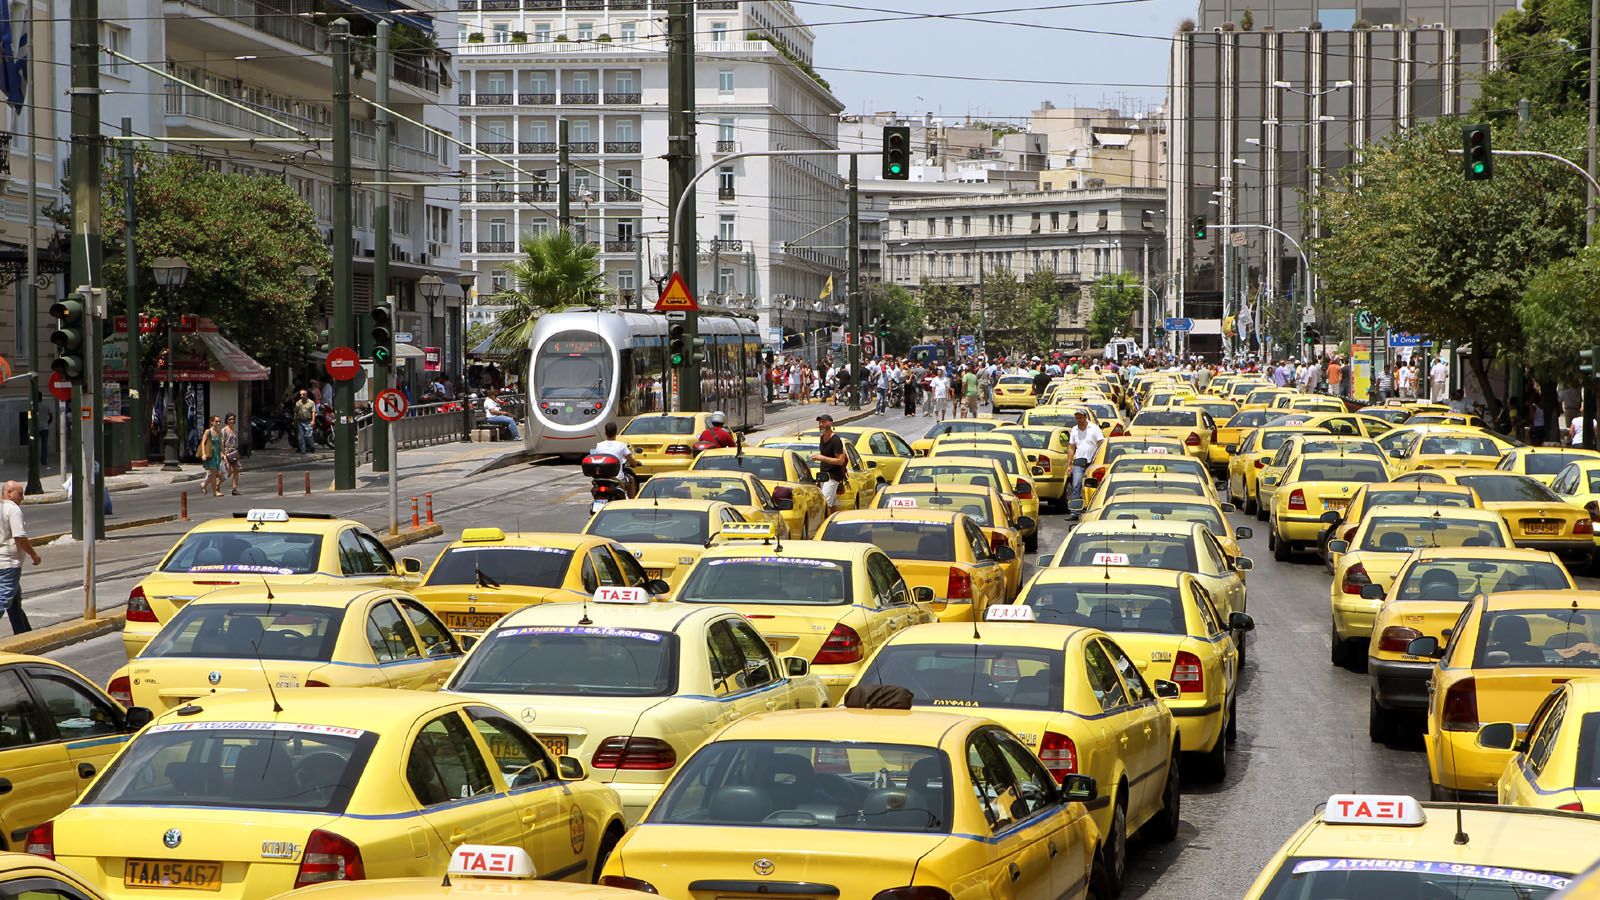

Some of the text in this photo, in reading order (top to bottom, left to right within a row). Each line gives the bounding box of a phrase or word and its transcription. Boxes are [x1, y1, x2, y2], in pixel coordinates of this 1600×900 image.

[600, 589, 639, 601] ΤΑΞΙ
[990, 607, 1029, 618] TAXI
[933, 699, 979, 707] ΓΛΥΦΑΔΑ
[1337, 800, 1404, 819] ΤΑΞΙ
[261, 841, 293, 854] OCTAVIA
[459, 851, 515, 872] ΤΑΞΙ
[1332, 859, 1416, 870] ATHENS
